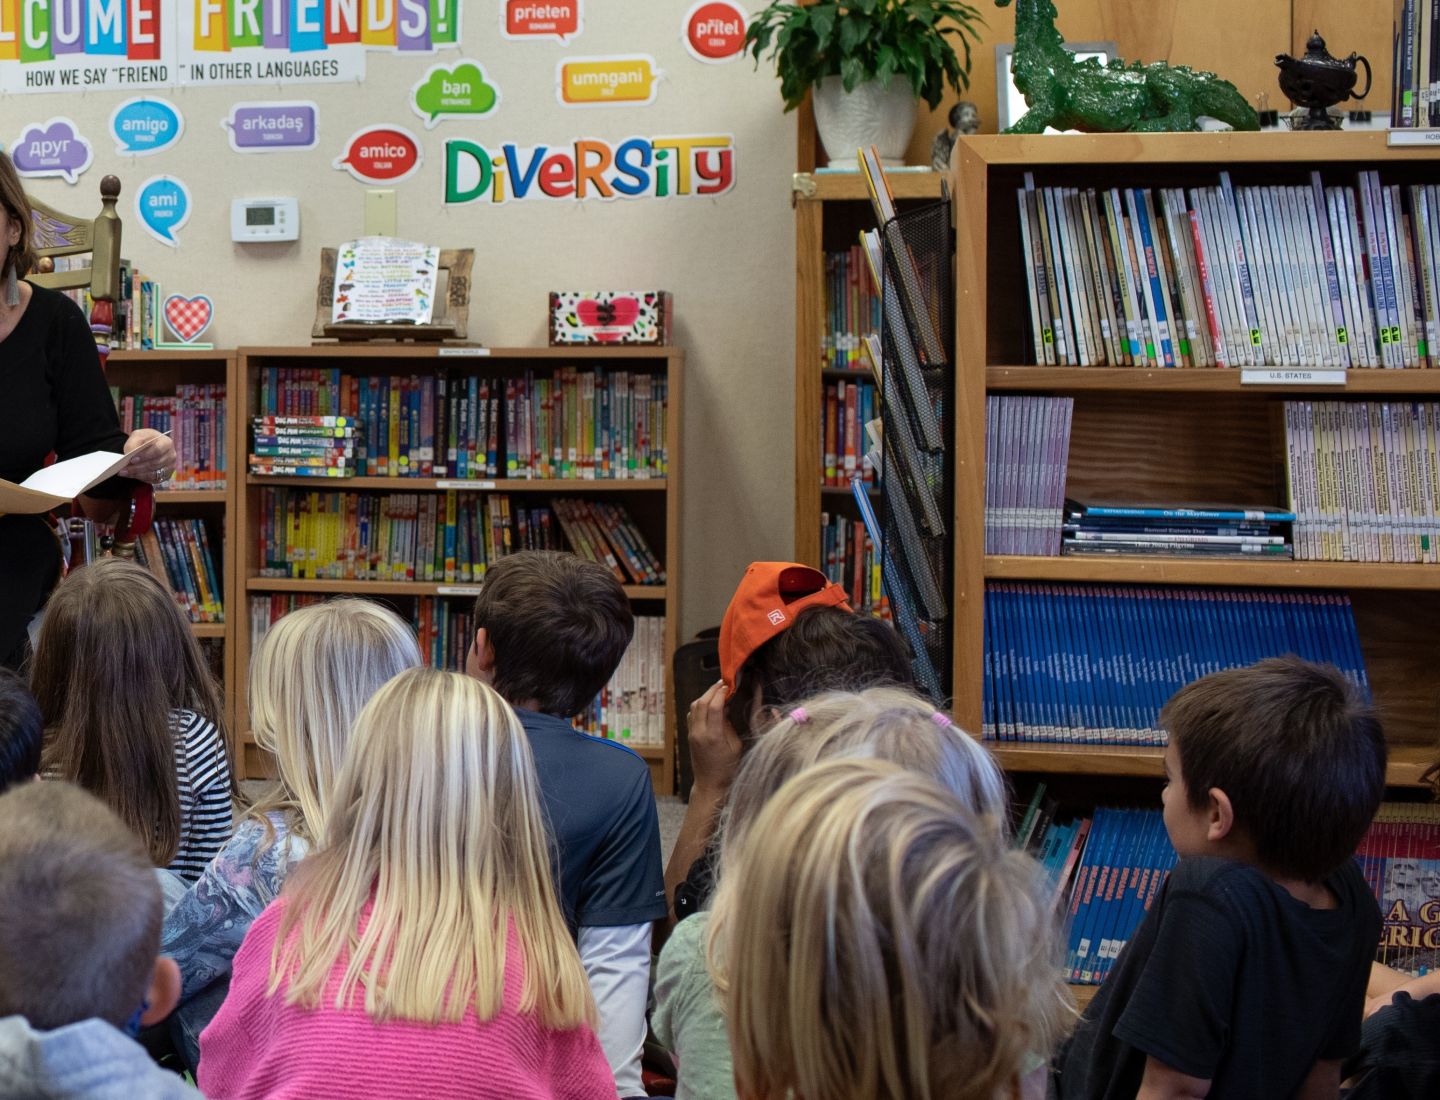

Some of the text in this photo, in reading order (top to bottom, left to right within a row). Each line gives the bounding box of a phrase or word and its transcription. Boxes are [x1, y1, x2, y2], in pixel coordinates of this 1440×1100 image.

[200, 0, 448, 38] FRIENDS!
[514, 3, 570, 22] prieten
[26, 71, 55, 86] HOW
[60, 69, 79, 85] WE
[84, 68, 108, 84] SAY
[191, 60, 204, 79] IN
[210, 61, 252, 79] OTHER
[258, 60, 339, 78] LANGUAGES
[572, 69, 643, 88] umngani
[442, 80, 471, 97] bạn
[122, 117, 169, 134] amigo
[242, 116, 303, 133] arkadaş
[30, 139, 71, 158] друг
[360, 142, 406, 158] amico
[149, 189, 177, 207] ami
[1327, 261, 1339, 301] NEW JERSEY
[1372, 256, 1383, 310] NORTH CAROLINA
[1382, 256, 1395, 310] NORTH CAROLINA
